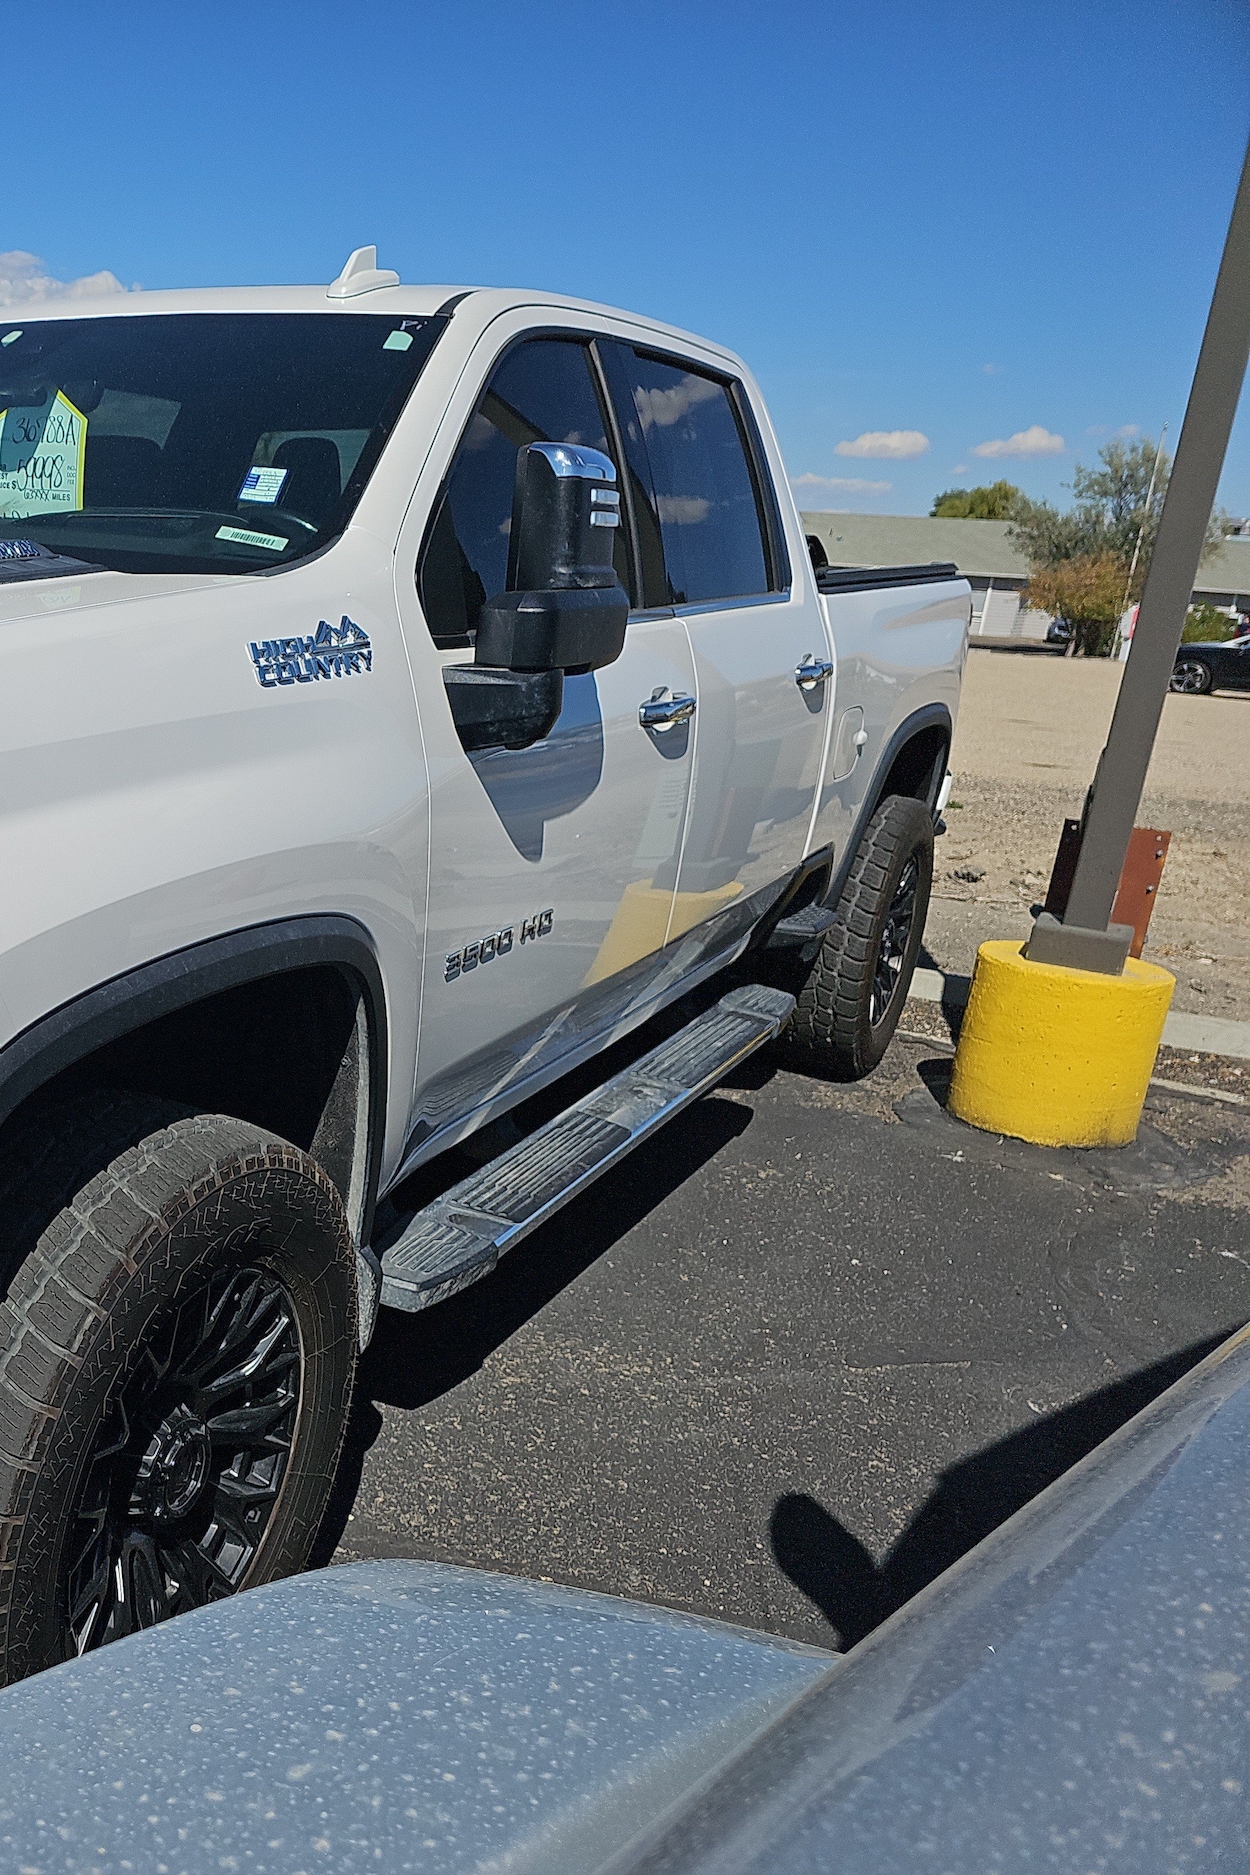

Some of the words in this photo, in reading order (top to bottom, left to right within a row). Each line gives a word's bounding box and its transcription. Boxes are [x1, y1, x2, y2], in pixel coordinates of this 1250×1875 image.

[52, 493, 71, 501] MILES
[247, 634, 316, 664] HIGH
[254, 650, 373, 688] COUNTRY
[519, 908, 554, 945] HD
